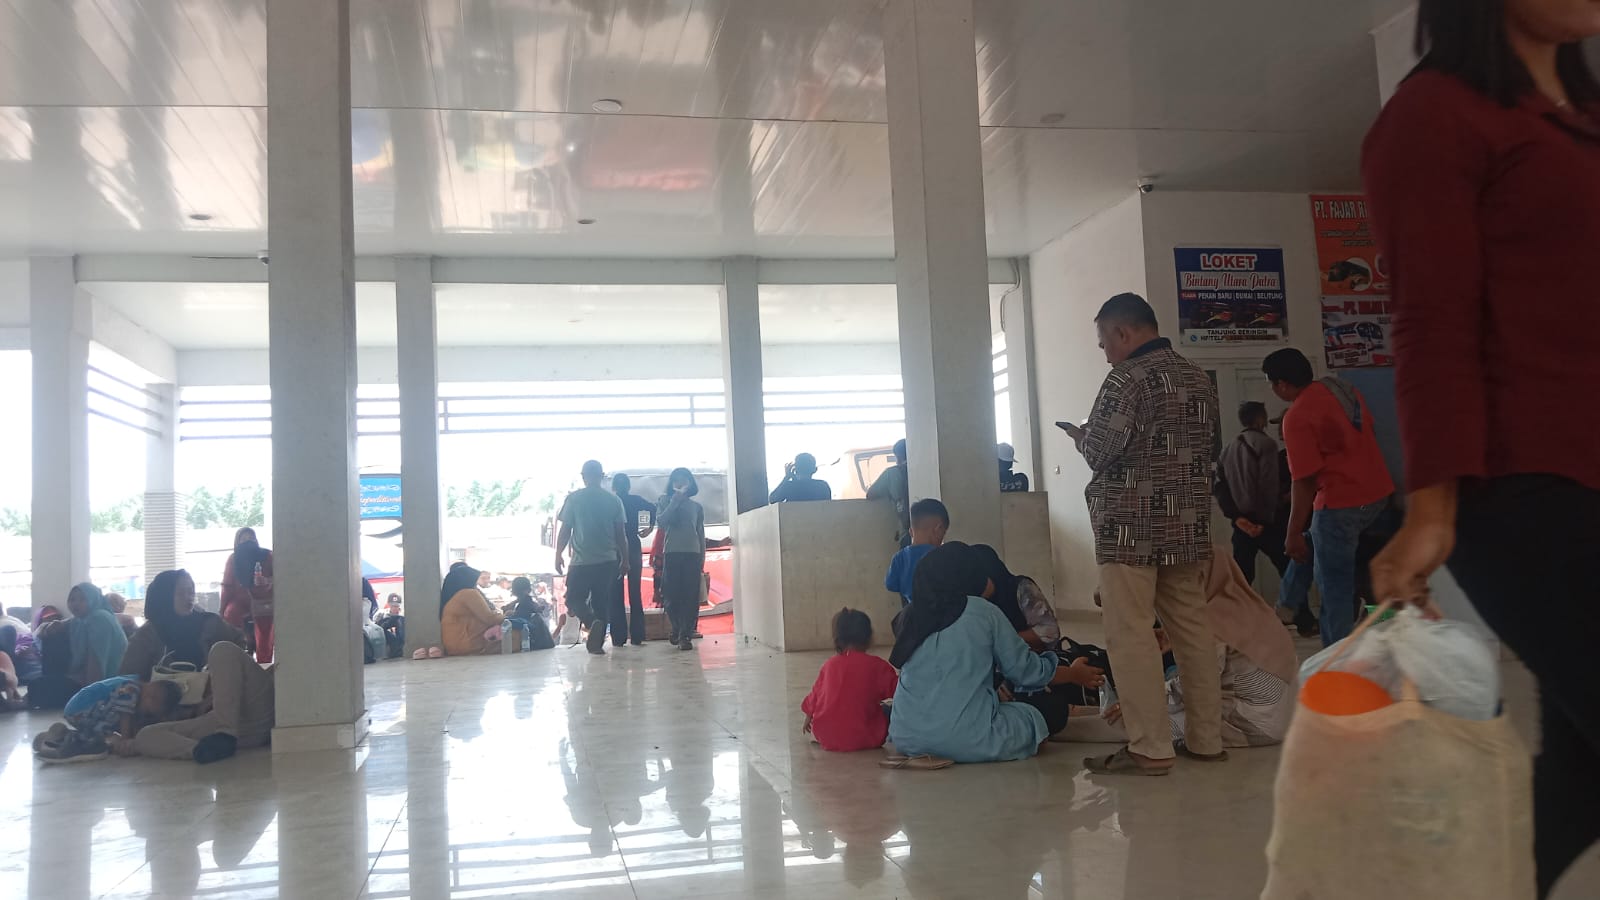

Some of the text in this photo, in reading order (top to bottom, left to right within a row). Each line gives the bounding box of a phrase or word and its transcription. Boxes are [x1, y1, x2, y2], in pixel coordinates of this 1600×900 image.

[1315, 200, 1328, 219] PT.
[1329, 200, 1356, 219] FAJAR
[1201, 253, 1257, 270] LOKET
[1184, 272, 1219, 291] Bintang
[1257, 292, 1283, 300] BELITUNG
